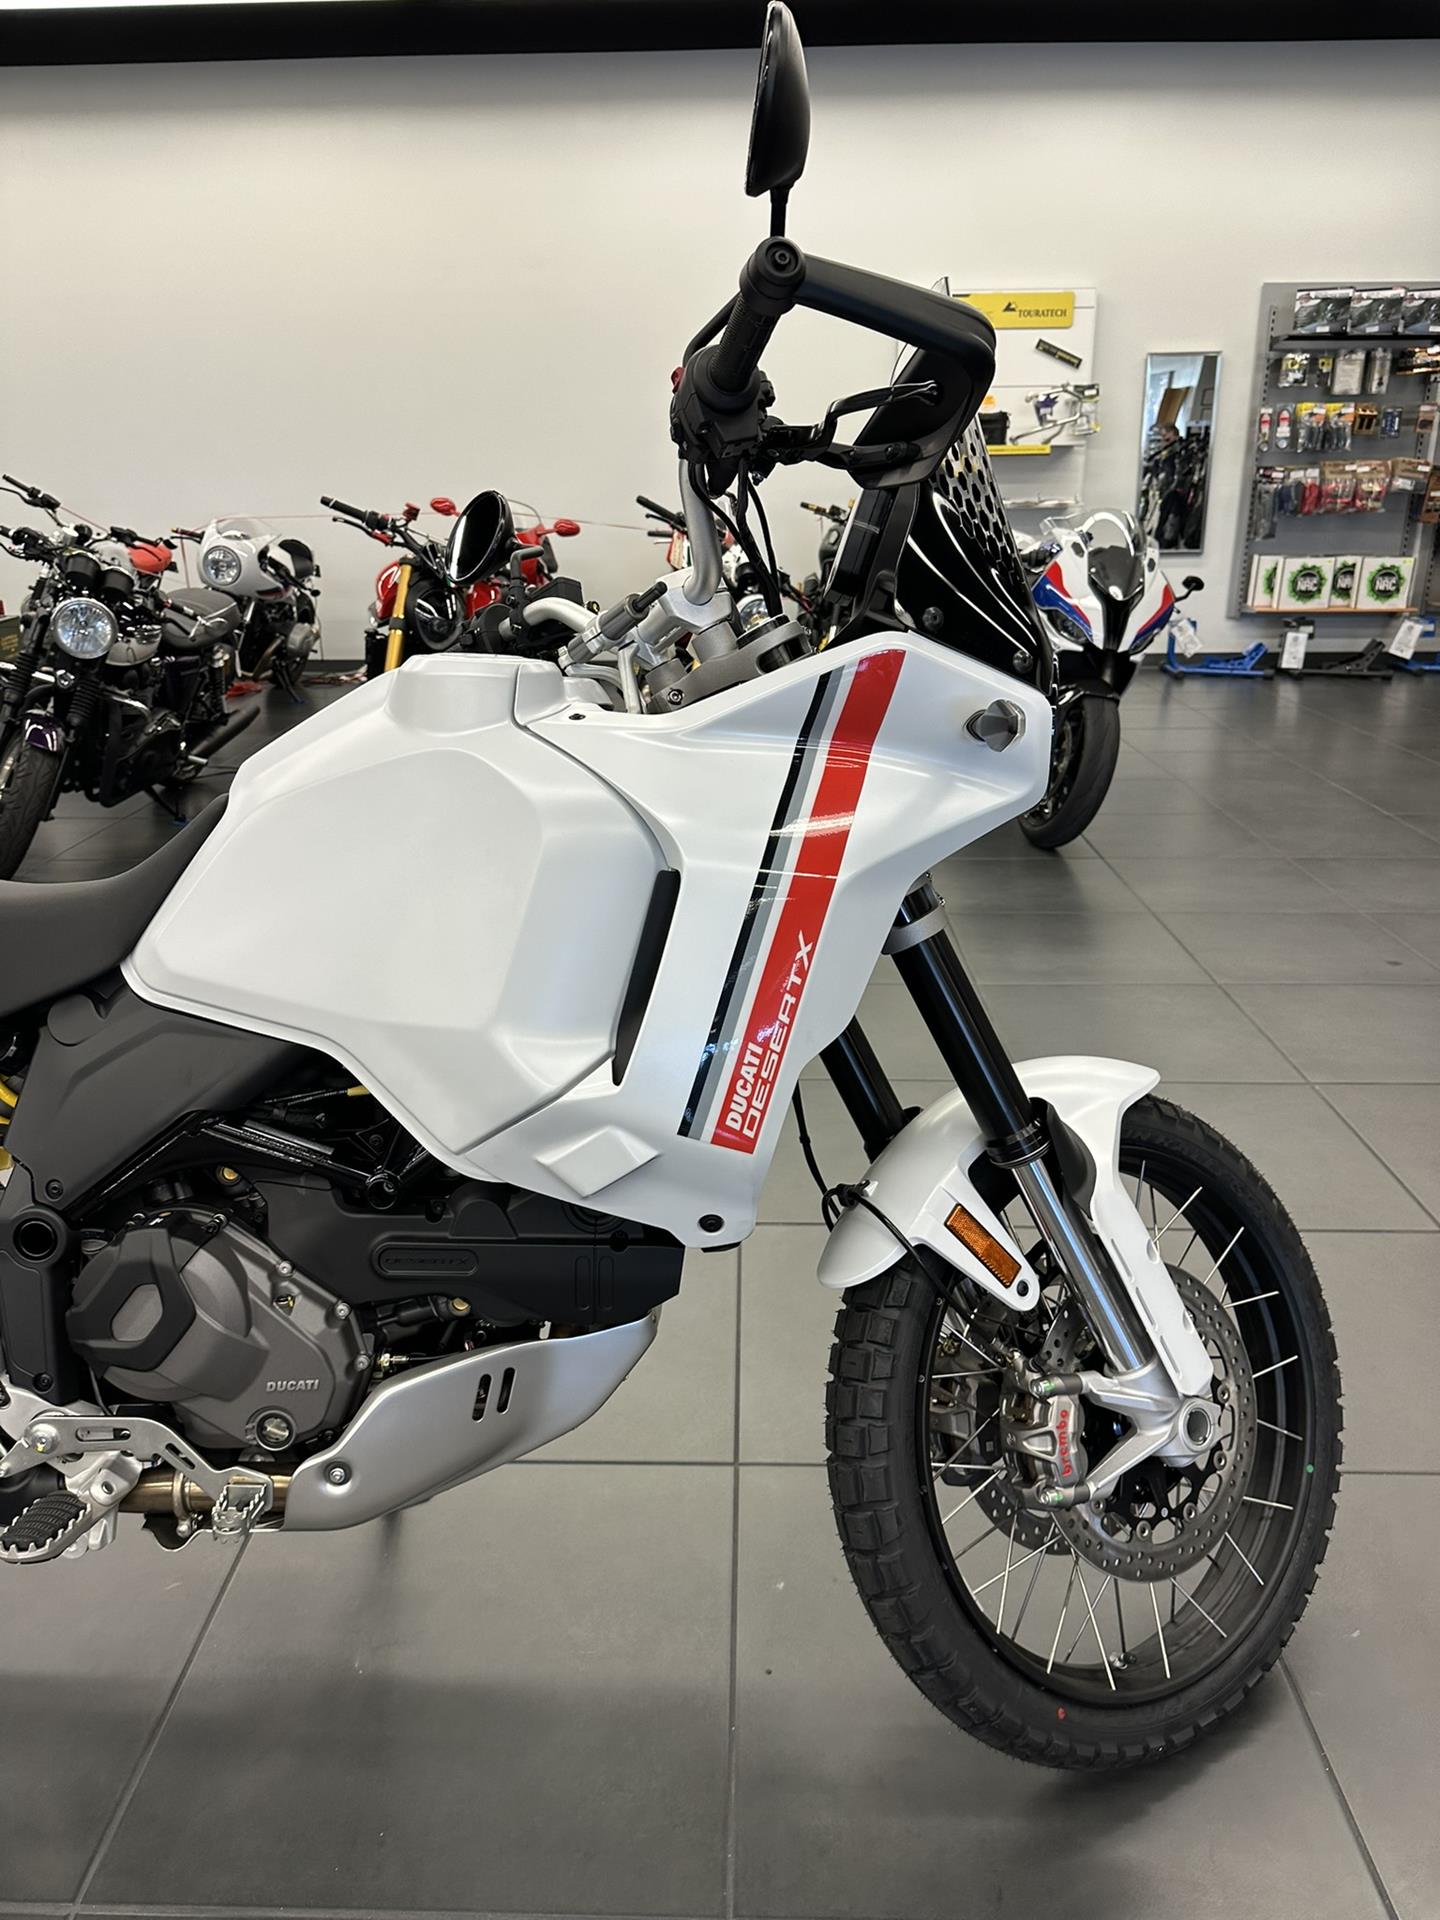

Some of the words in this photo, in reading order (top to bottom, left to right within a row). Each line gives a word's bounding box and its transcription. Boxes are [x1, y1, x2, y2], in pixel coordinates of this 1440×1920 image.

[1018, 308, 1067, 318] TOURATECH
[725, 1042, 763, 1131] DUCATI
[266, 1379, 320, 1392] DUCATI
[1056, 1409, 1073, 1477] brembo
